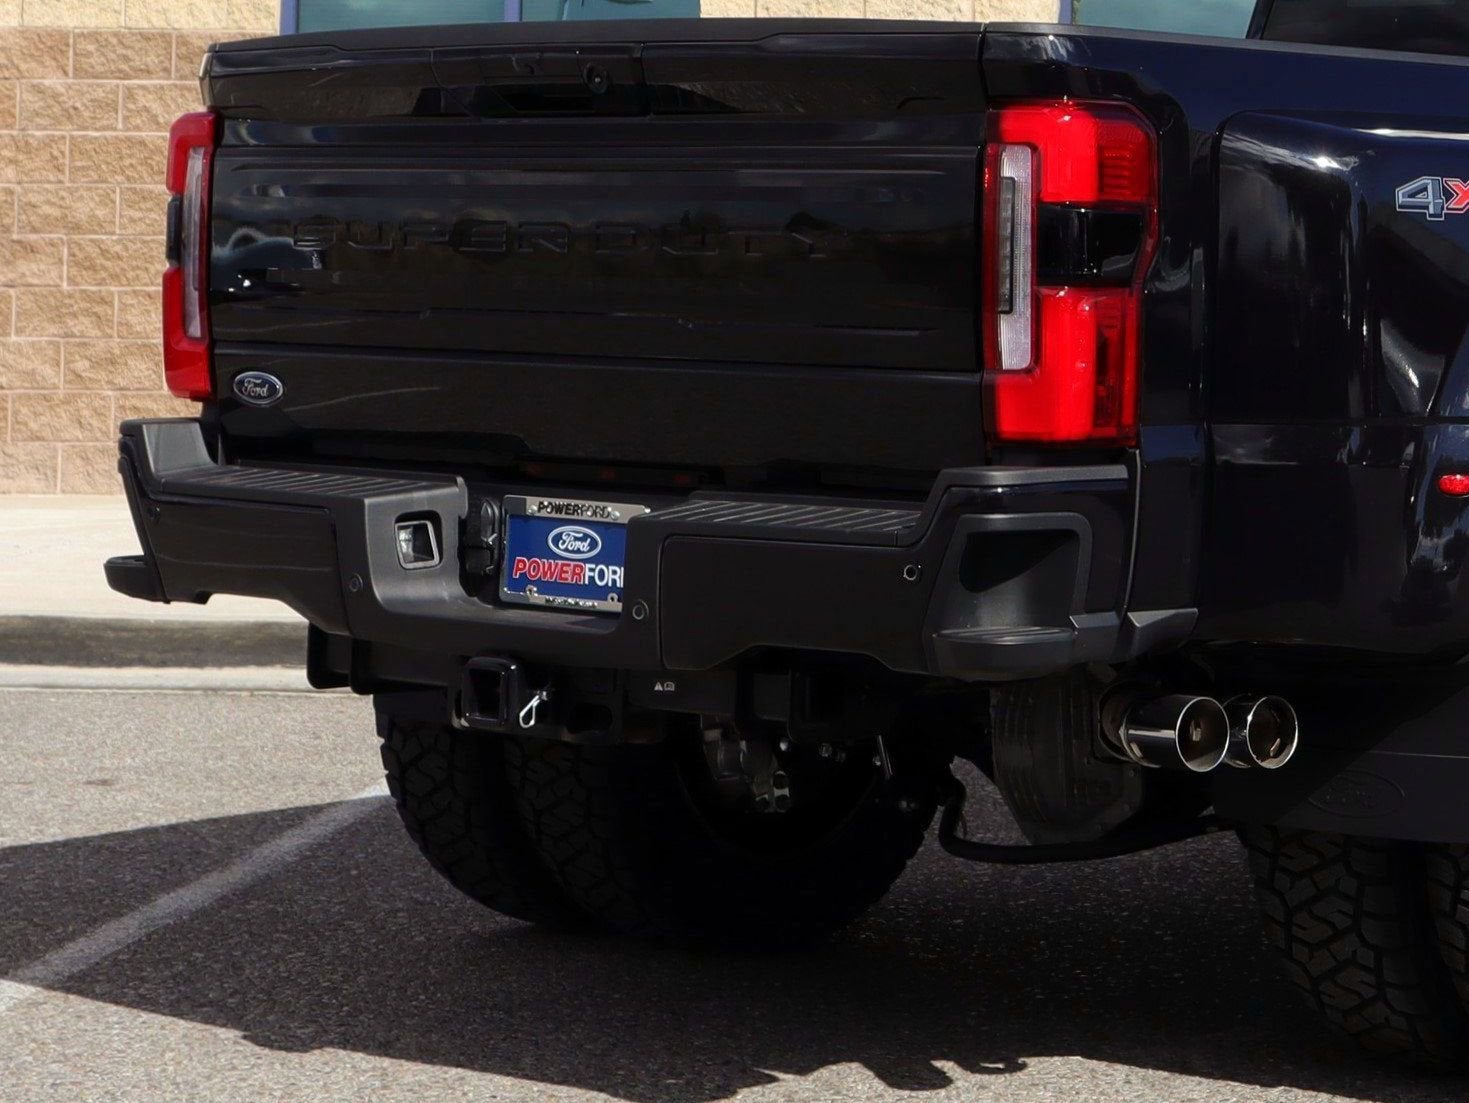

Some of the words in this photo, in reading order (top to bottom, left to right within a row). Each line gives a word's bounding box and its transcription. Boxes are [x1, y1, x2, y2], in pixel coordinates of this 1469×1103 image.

[241, 377, 270, 398] Ford
[537, 500, 611, 520] POWERFORD
[558, 532, 591, 552] Ford
[513, 556, 625, 589] POWERFOR
